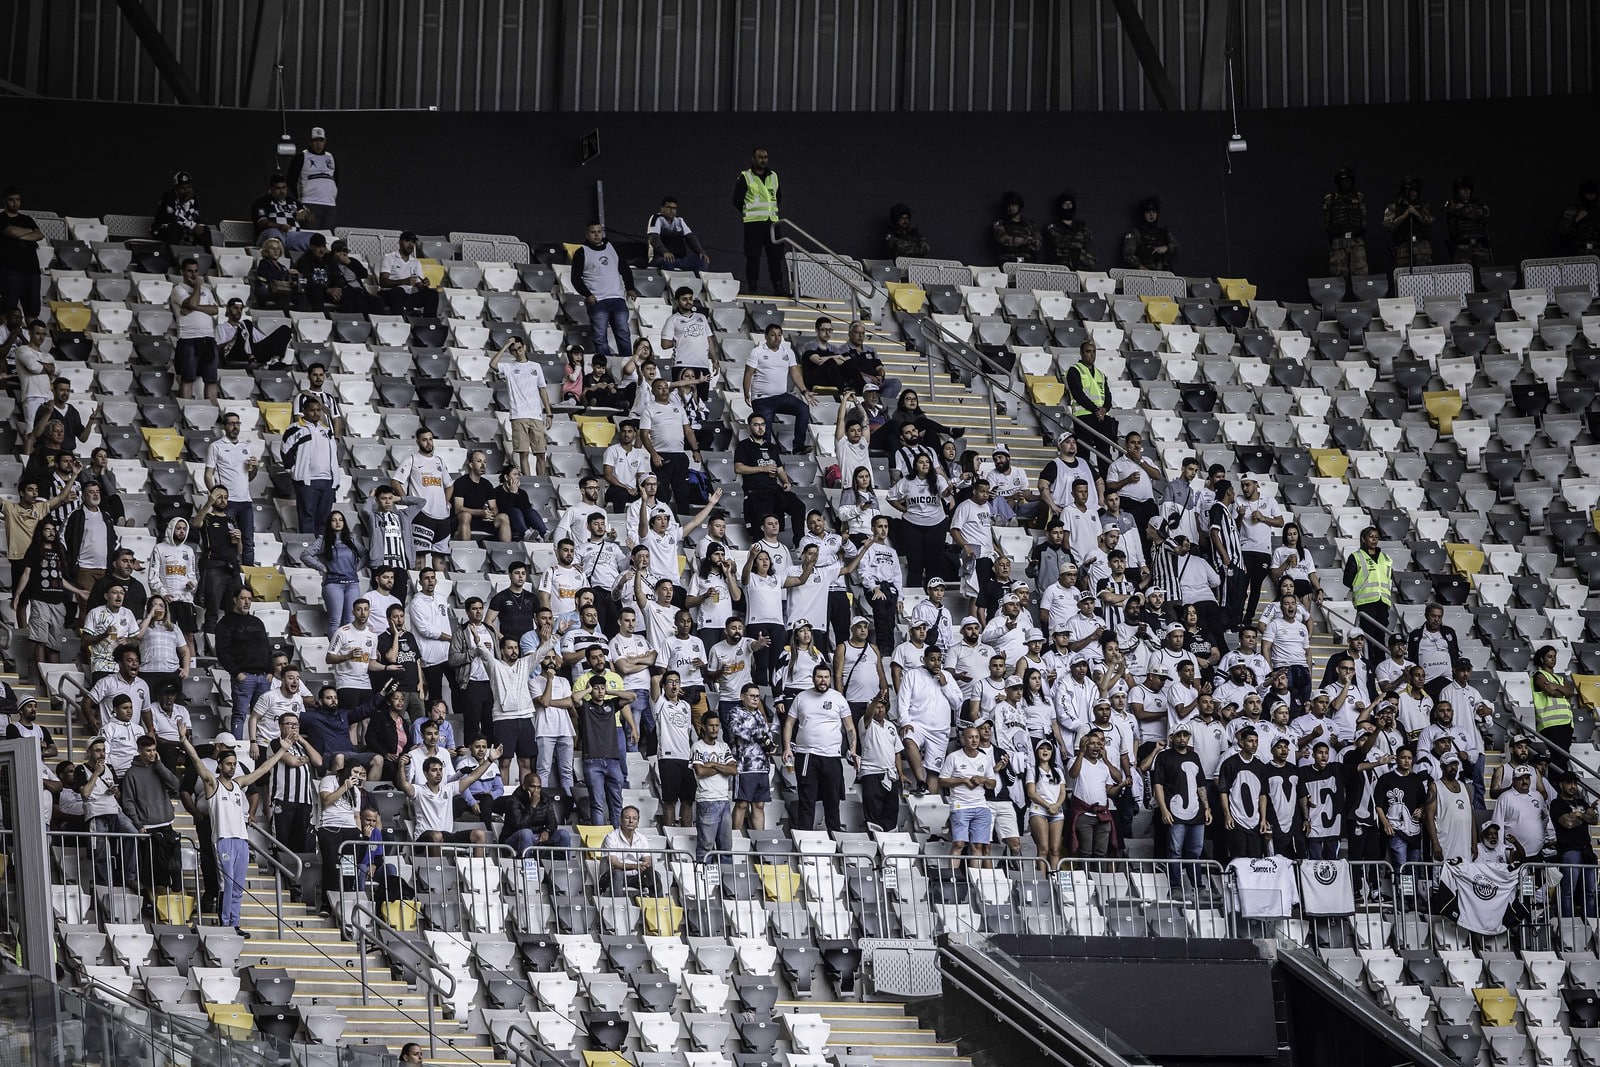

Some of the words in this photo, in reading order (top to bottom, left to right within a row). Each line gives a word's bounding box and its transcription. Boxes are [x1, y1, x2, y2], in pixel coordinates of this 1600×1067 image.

[1170, 761, 1199, 820] J
[1230, 770, 1261, 829] O
[1267, 774, 1298, 834] V
[1304, 776, 1341, 837] E
